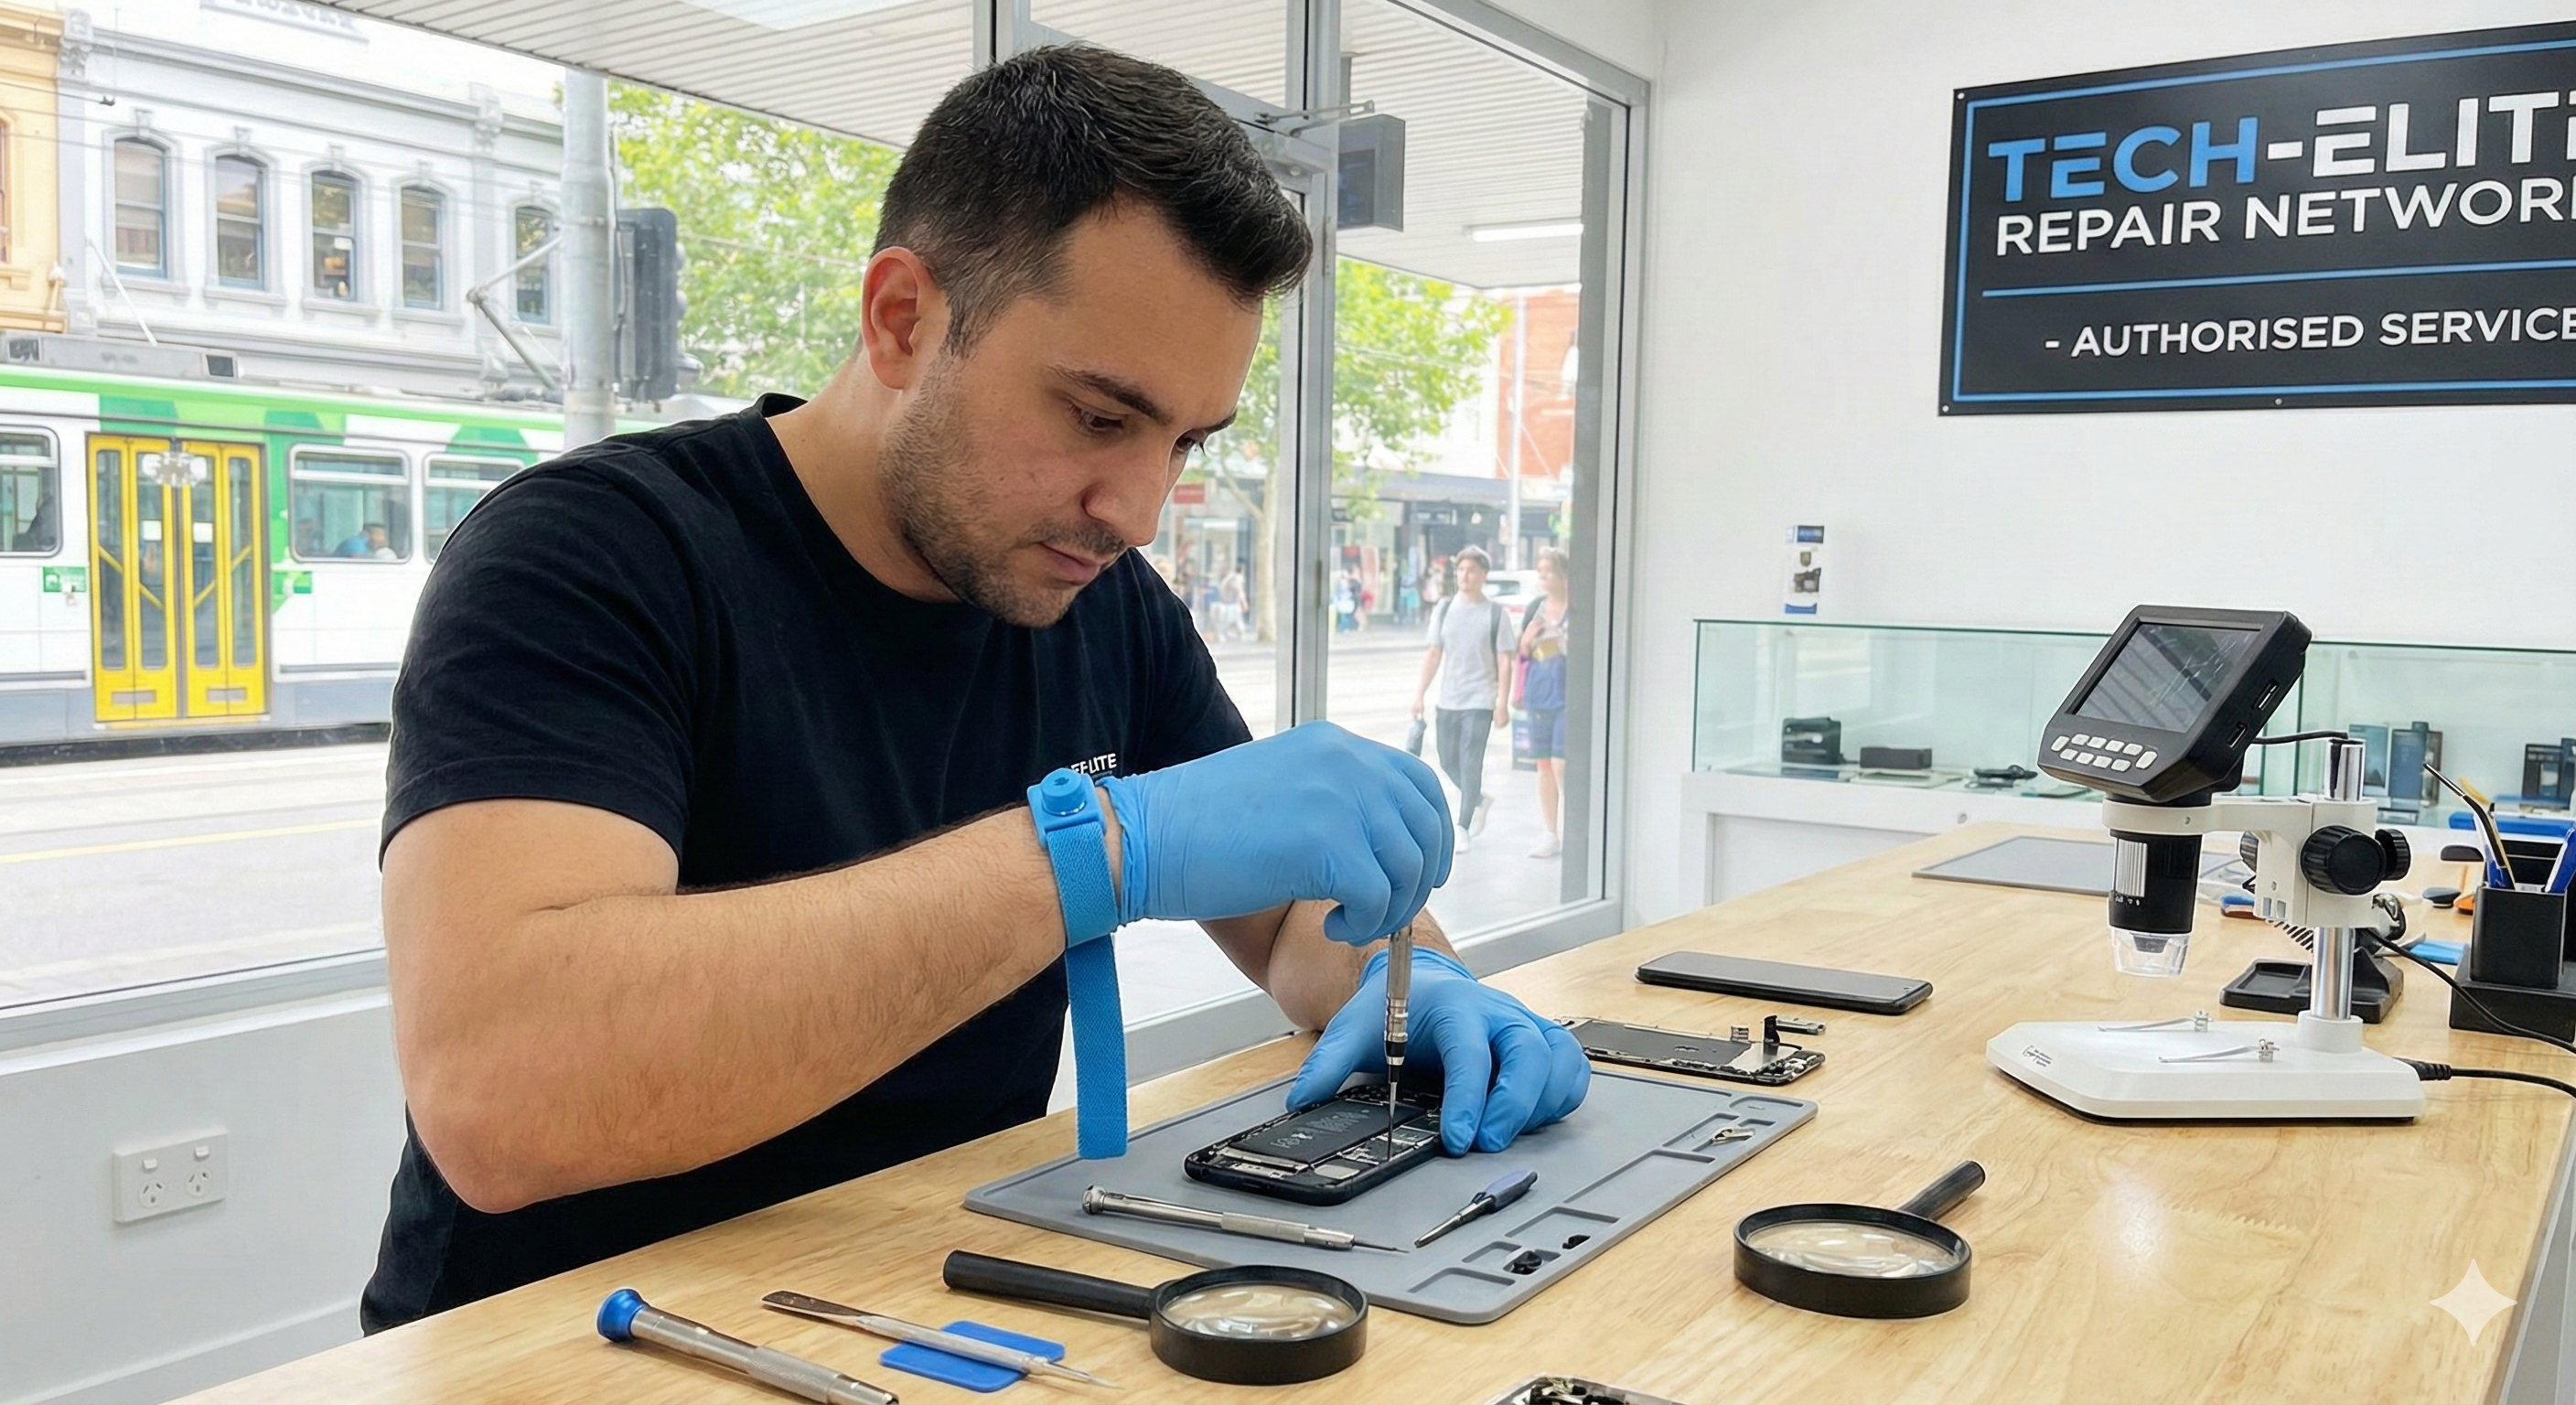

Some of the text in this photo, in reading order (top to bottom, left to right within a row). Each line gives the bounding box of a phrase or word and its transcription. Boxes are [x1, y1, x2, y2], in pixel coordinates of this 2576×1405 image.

[1988, 90, 2576, 201] TECH-ELIT
[1997, 175, 2576, 256] REPAIR NETWOR
[2071, 315, 2365, 358] AUTHORISED
